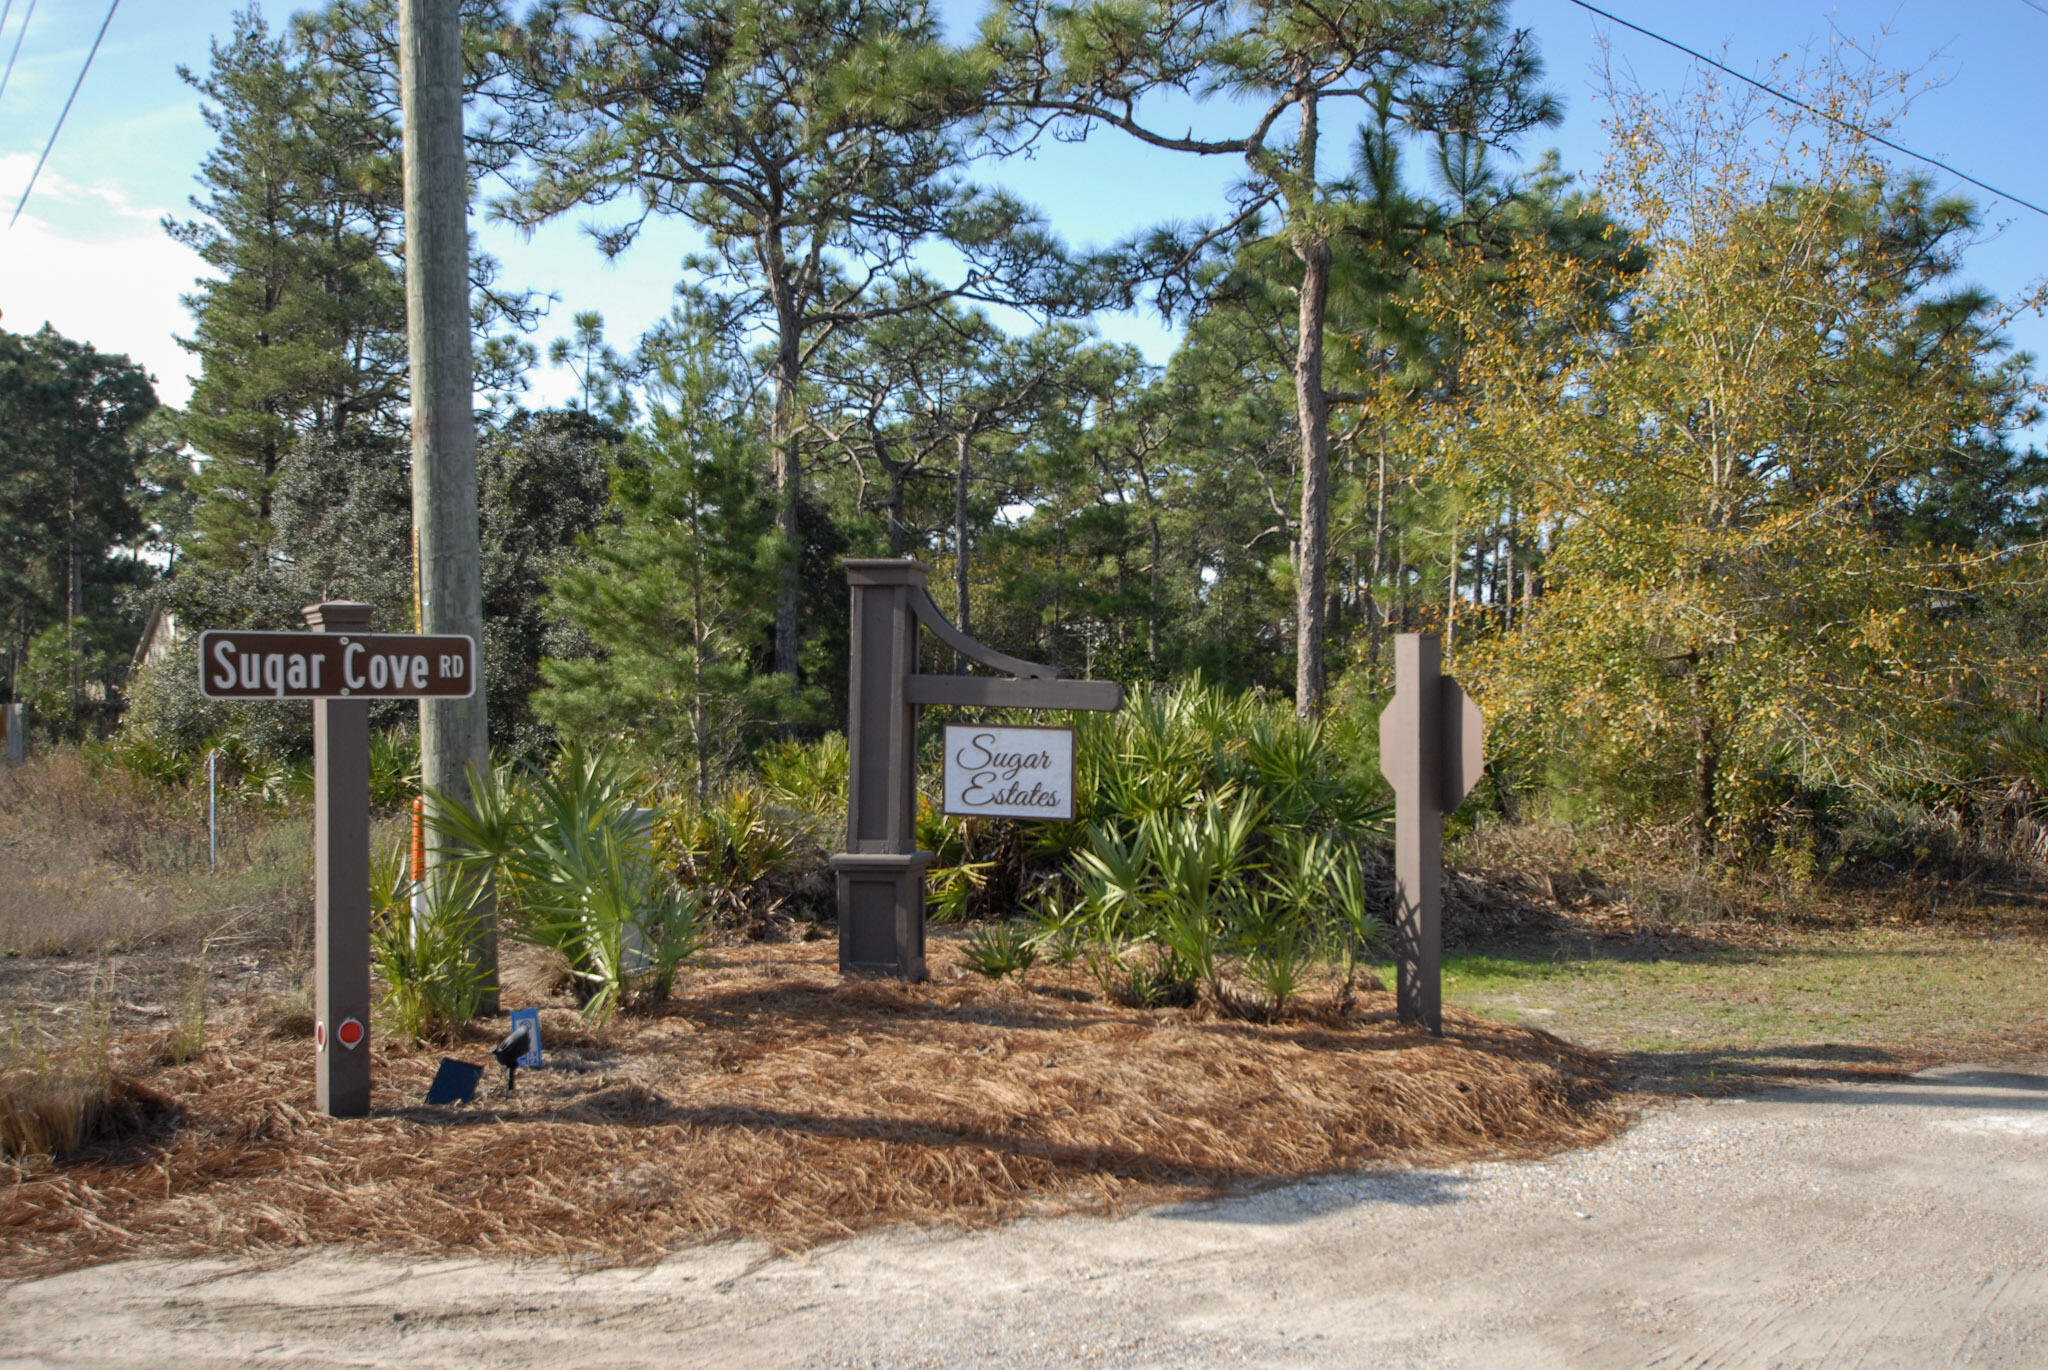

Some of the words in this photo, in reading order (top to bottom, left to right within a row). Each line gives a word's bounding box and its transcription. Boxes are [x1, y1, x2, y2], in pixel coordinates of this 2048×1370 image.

[343, 642, 429, 689] Cove
[439, 654, 464, 679] RD
[956, 733, 1052, 781] Sugar
[961, 771, 1062, 807] Estates
